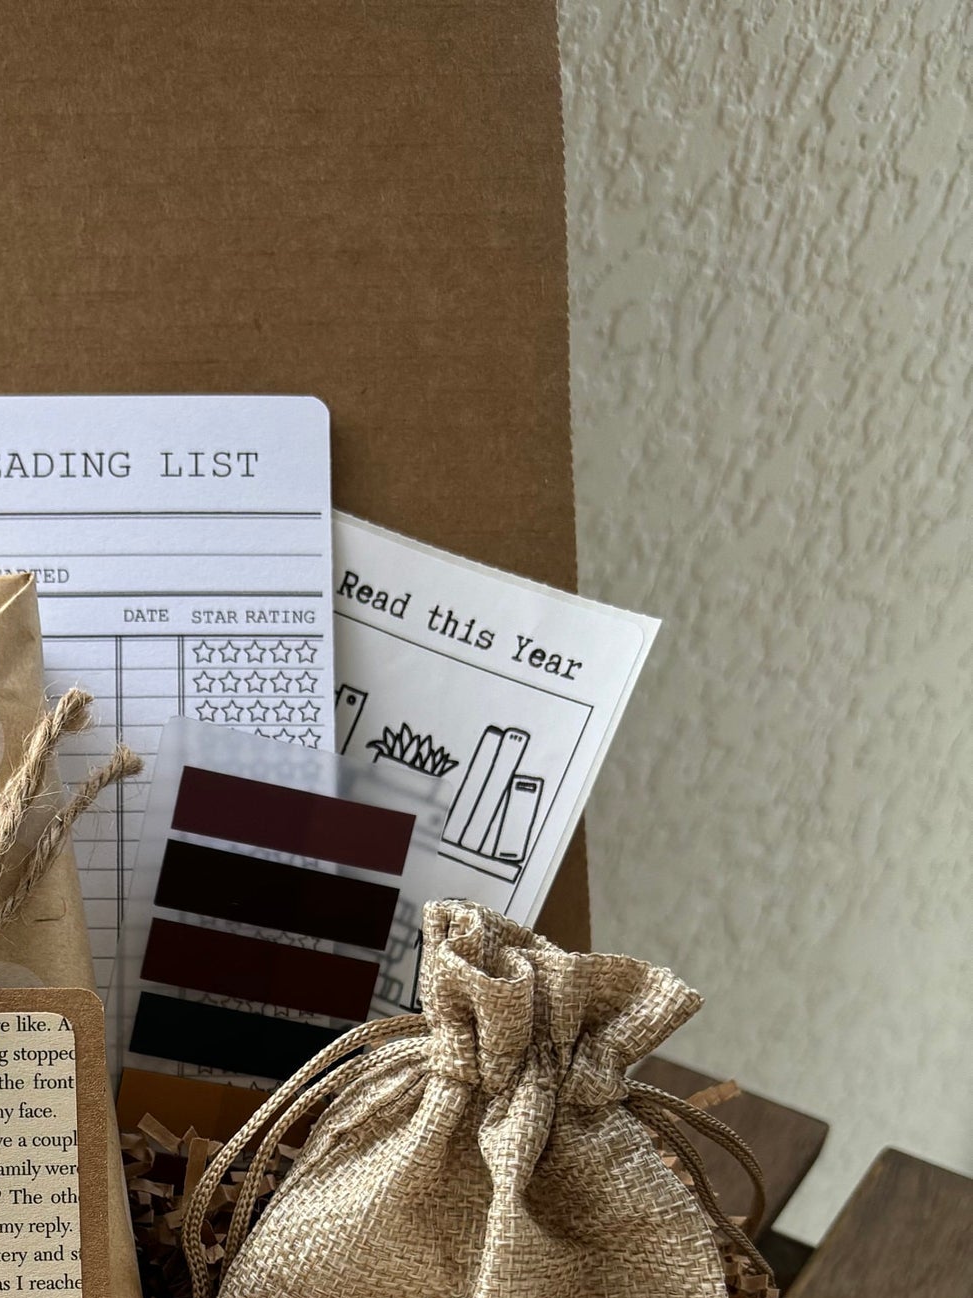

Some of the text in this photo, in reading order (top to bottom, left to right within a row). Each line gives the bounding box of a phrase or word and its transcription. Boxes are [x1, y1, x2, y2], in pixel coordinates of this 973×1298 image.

[160, 451, 260, 479] LIST
[123, 608, 316, 625] DATE STAR RATING
[336, 570, 583, 681] Read this Year
[17, 1015, 50, 1031] like.
[33, 1073, 74, 1089] front
[19, 1102, 56, 1118] face.
[18, 1137, 27, 1147] a
[9, 1188, 42, 1204] The
[0, 1223, 24, 1238] my
[29, 1216, 72, 1238] reply.
[34, 1245, 64, 1261] and
[16, 1275, 23, 1290] I
